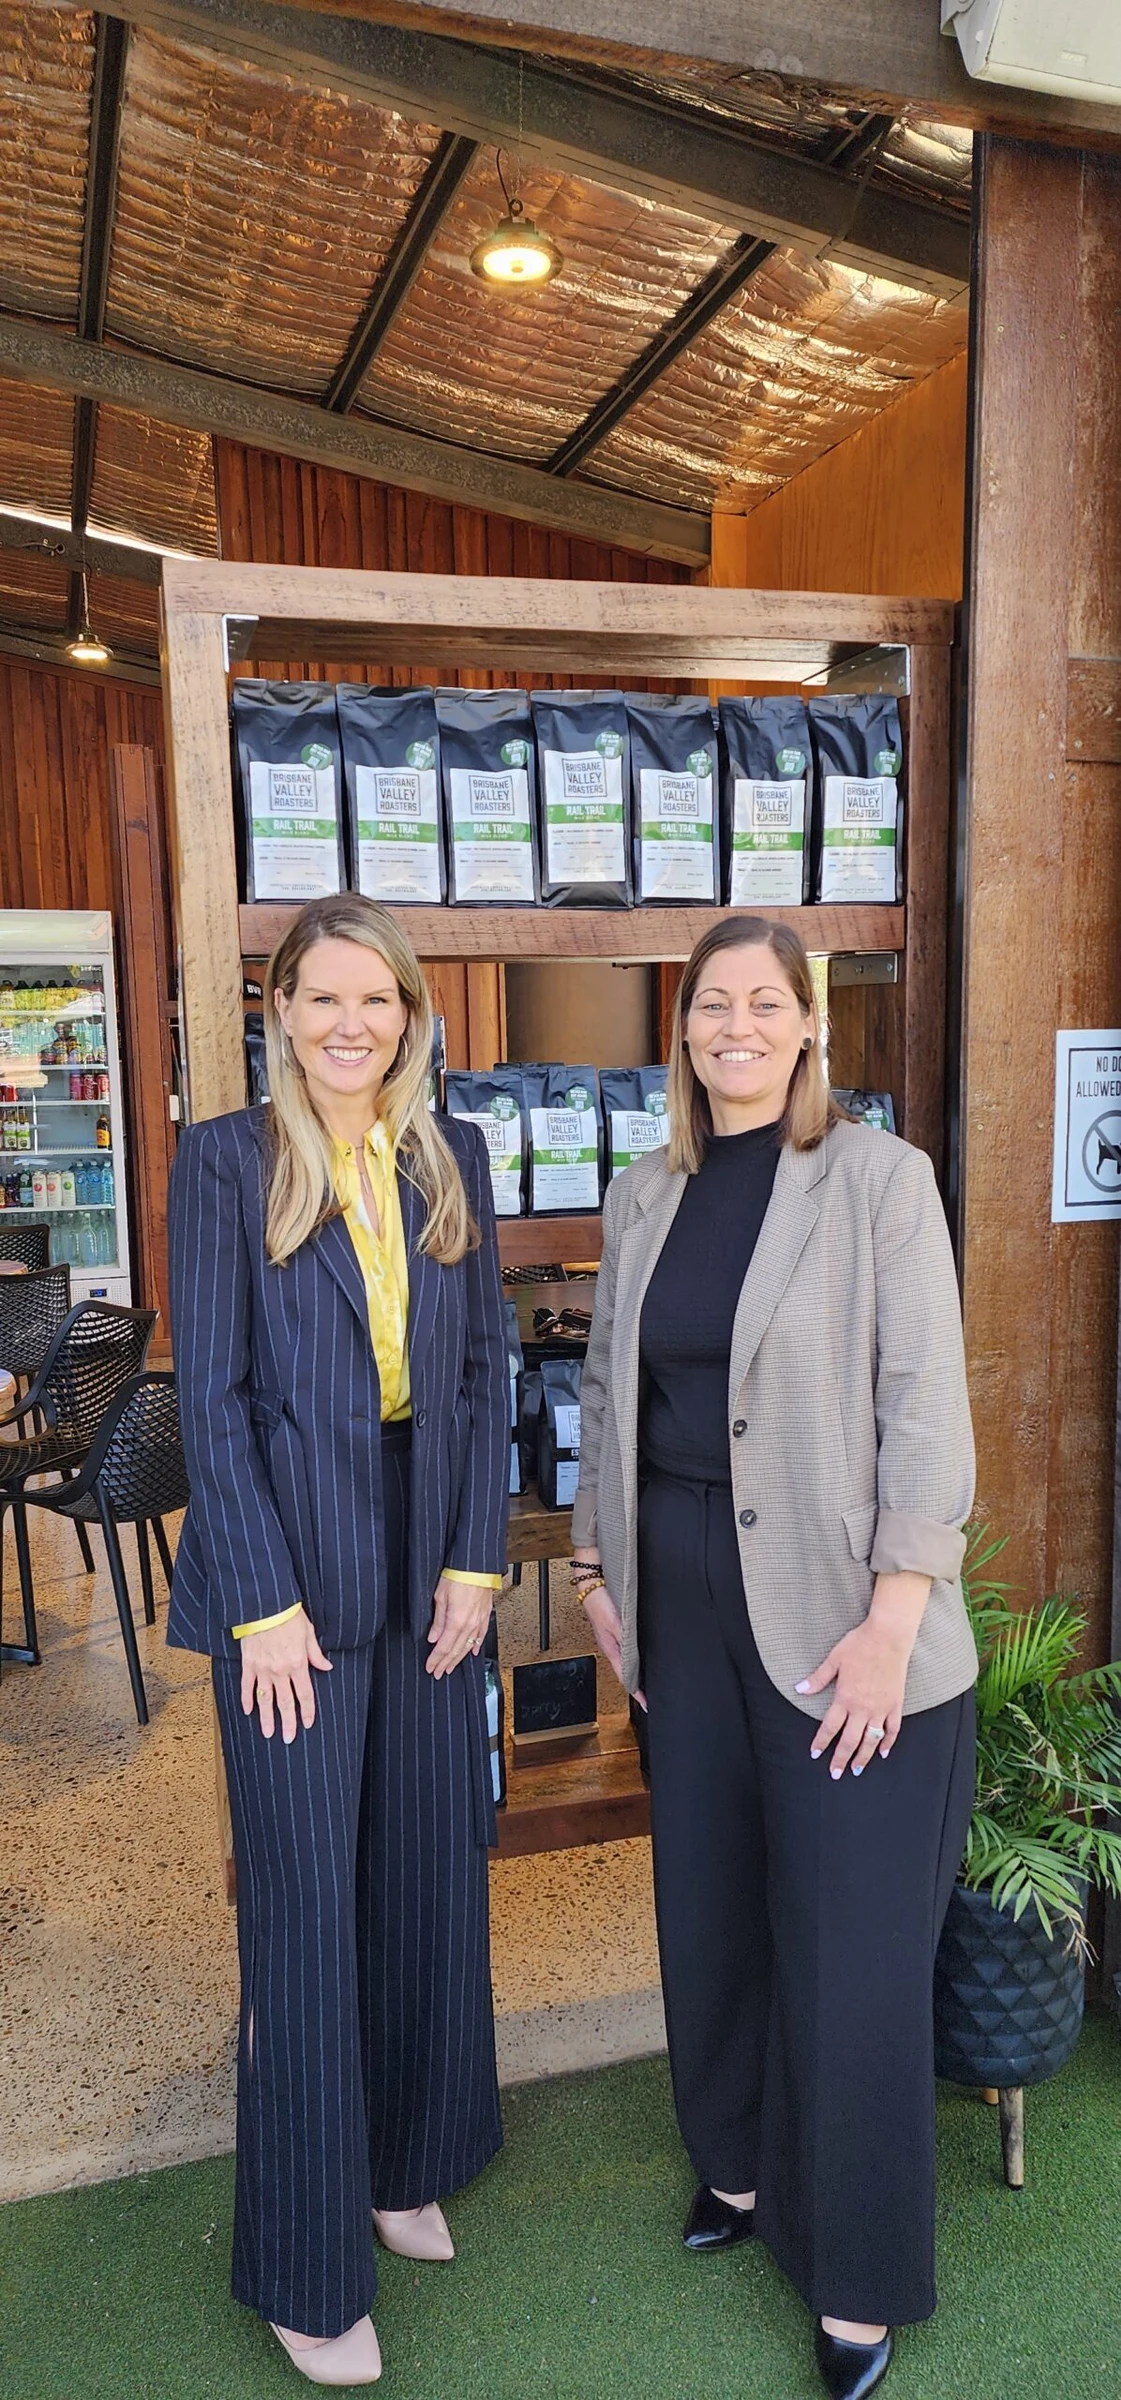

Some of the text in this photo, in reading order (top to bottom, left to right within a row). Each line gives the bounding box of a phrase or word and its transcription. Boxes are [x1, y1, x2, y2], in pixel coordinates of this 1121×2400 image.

[565, 761, 602, 772] BRISBANE
[273, 773, 313, 784] BRISBANE
[378, 777, 416, 788] BRISBANE
[567, 772, 602, 784] VALLEY
[472, 779, 510, 789] BRISBANE
[568, 784, 604, 795] ROASTERS
[661, 780, 695, 790] BRISBANE
[274, 783, 313, 797] VALLEY
[380, 787, 416, 800] VALLEY
[474, 789, 510, 801] VALLEY
[756, 790, 789, 800] BRISBANE
[846, 786, 880, 796] BRISBANE
[662, 790, 695, 802] VALLEY
[274, 797, 314, 808] ROASTERS
[380, 801, 417, 812] ROASTERS
[474, 802, 511, 811] ROASTERS
[663, 802, 696, 813] ROASTERS
[756, 800, 789, 812] VALLEY
[847, 796, 880, 808] VALLEY
[567, 805, 606, 816] RAIL TRAIL
[846, 809, 880, 819] ROASTERS
[273, 819, 317, 832] RAIL TRAIL
[378, 822, 420, 835] RAIL TRAIL
[473, 823, 514, 834] RAIL TRAIL
[660, 823, 698, 835] RAIL TRAIL
[843, 829, 882, 840] RAIL TRAIL
[1096, 1055, 1109, 1073] NO
[1075, 1080, 1121, 1098] ALLOWED
[549, 1115, 578, 1124] BRISBANE
[551, 1124, 578, 1134] VALLEY
[630, 1126, 658, 1136] VALLEY
[551, 1133, 580, 1142] ROASTERS
